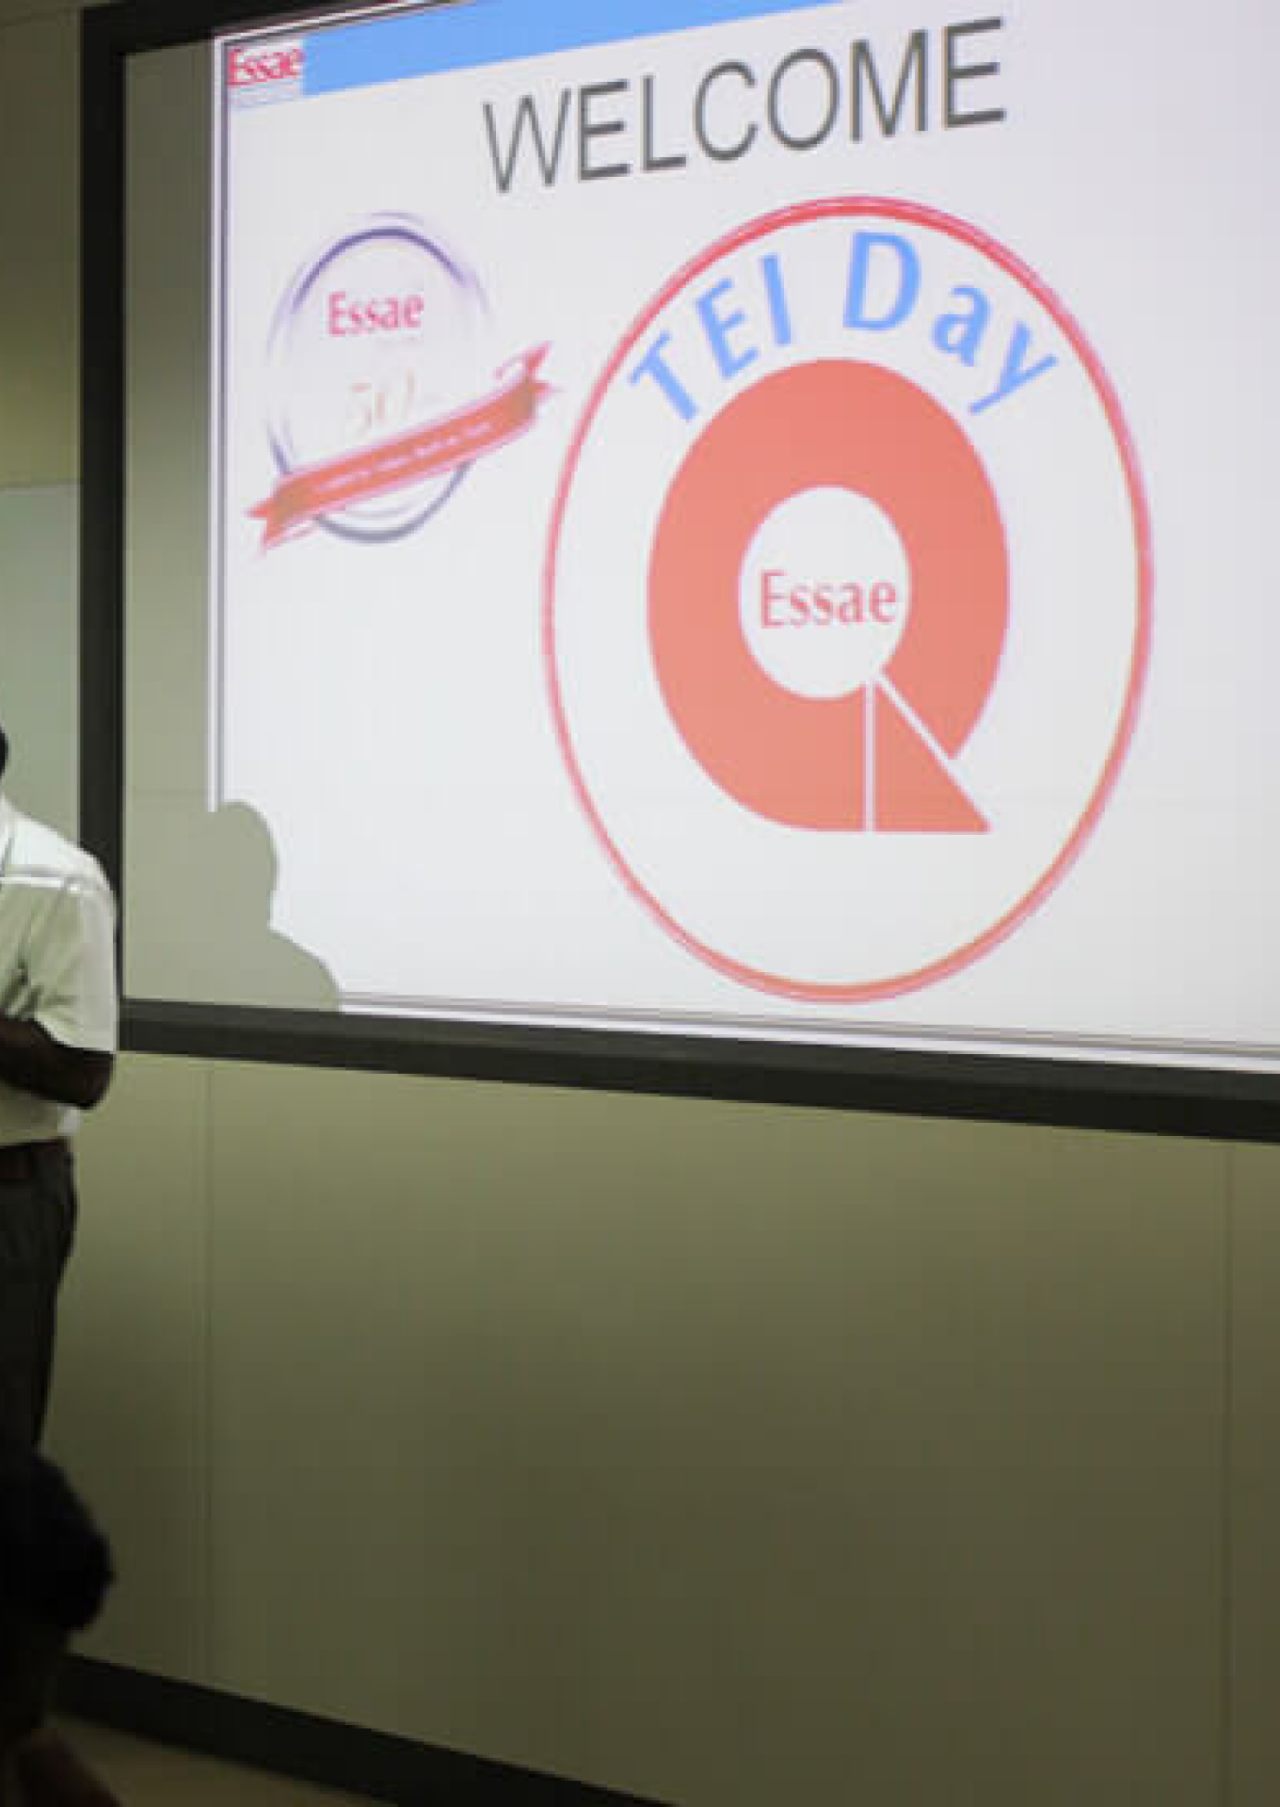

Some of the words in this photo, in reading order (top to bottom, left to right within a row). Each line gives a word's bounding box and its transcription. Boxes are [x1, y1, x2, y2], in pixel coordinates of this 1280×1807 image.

[227, 48, 305, 87] Essae
[483, 16, 1006, 193] WELCOME
[327, 290, 424, 337] Essae
[628, 251, 792, 422] TEI
[842, 230, 1058, 415] Day
[760, 568, 898, 629] Essae
